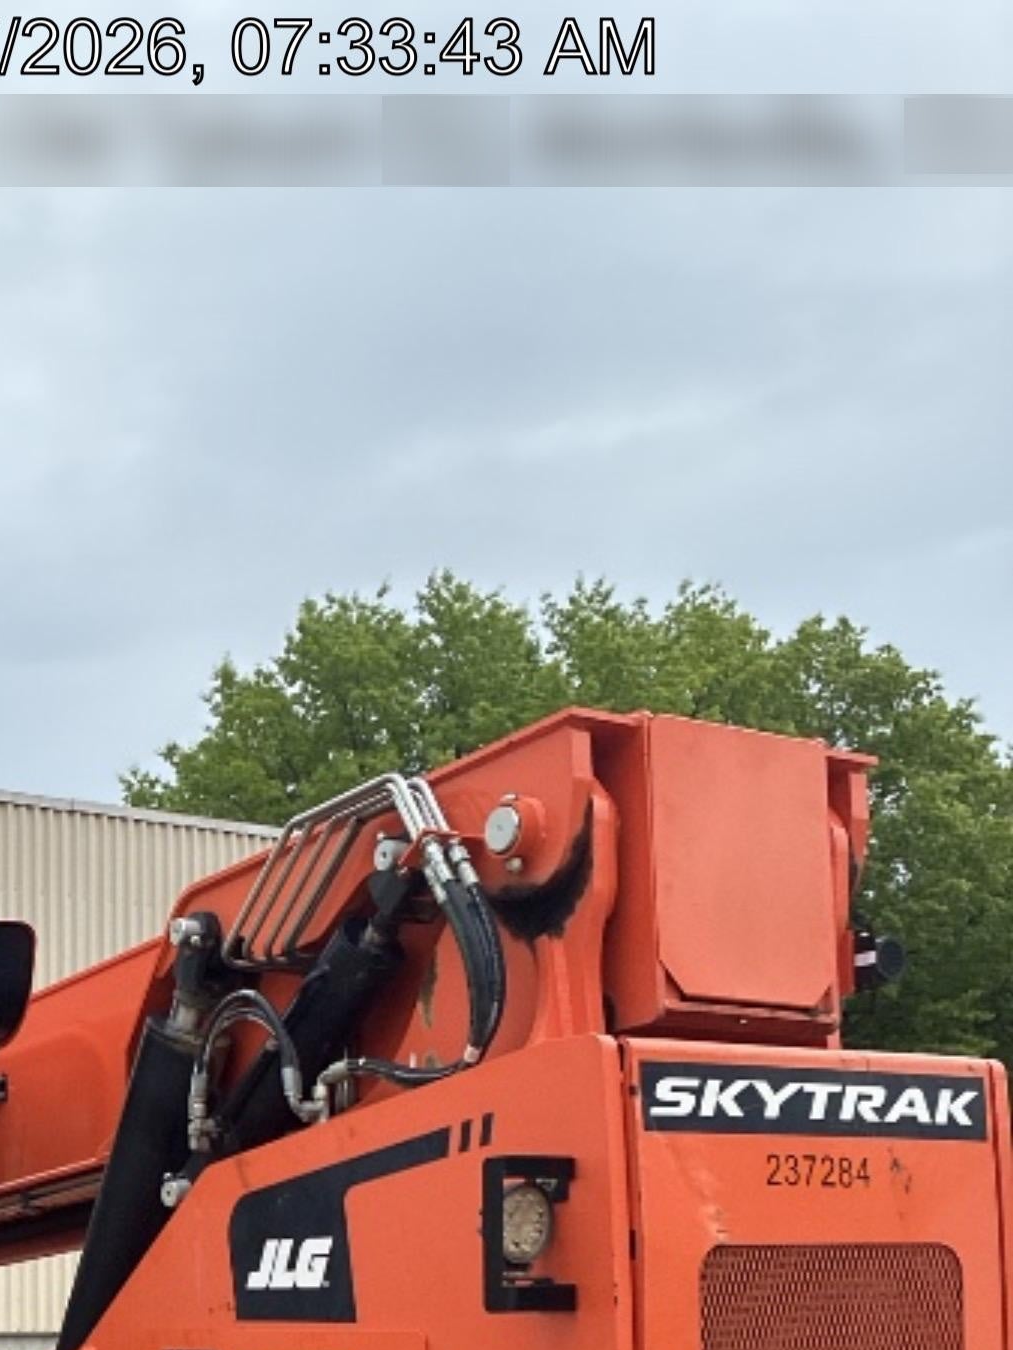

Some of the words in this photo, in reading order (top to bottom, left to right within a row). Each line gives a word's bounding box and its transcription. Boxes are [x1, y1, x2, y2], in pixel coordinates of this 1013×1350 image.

[649, 1076, 979, 1126] SKYTRAK
[766, 1153, 871, 1189] 237284
[245, 1236, 333, 1291] JLG
